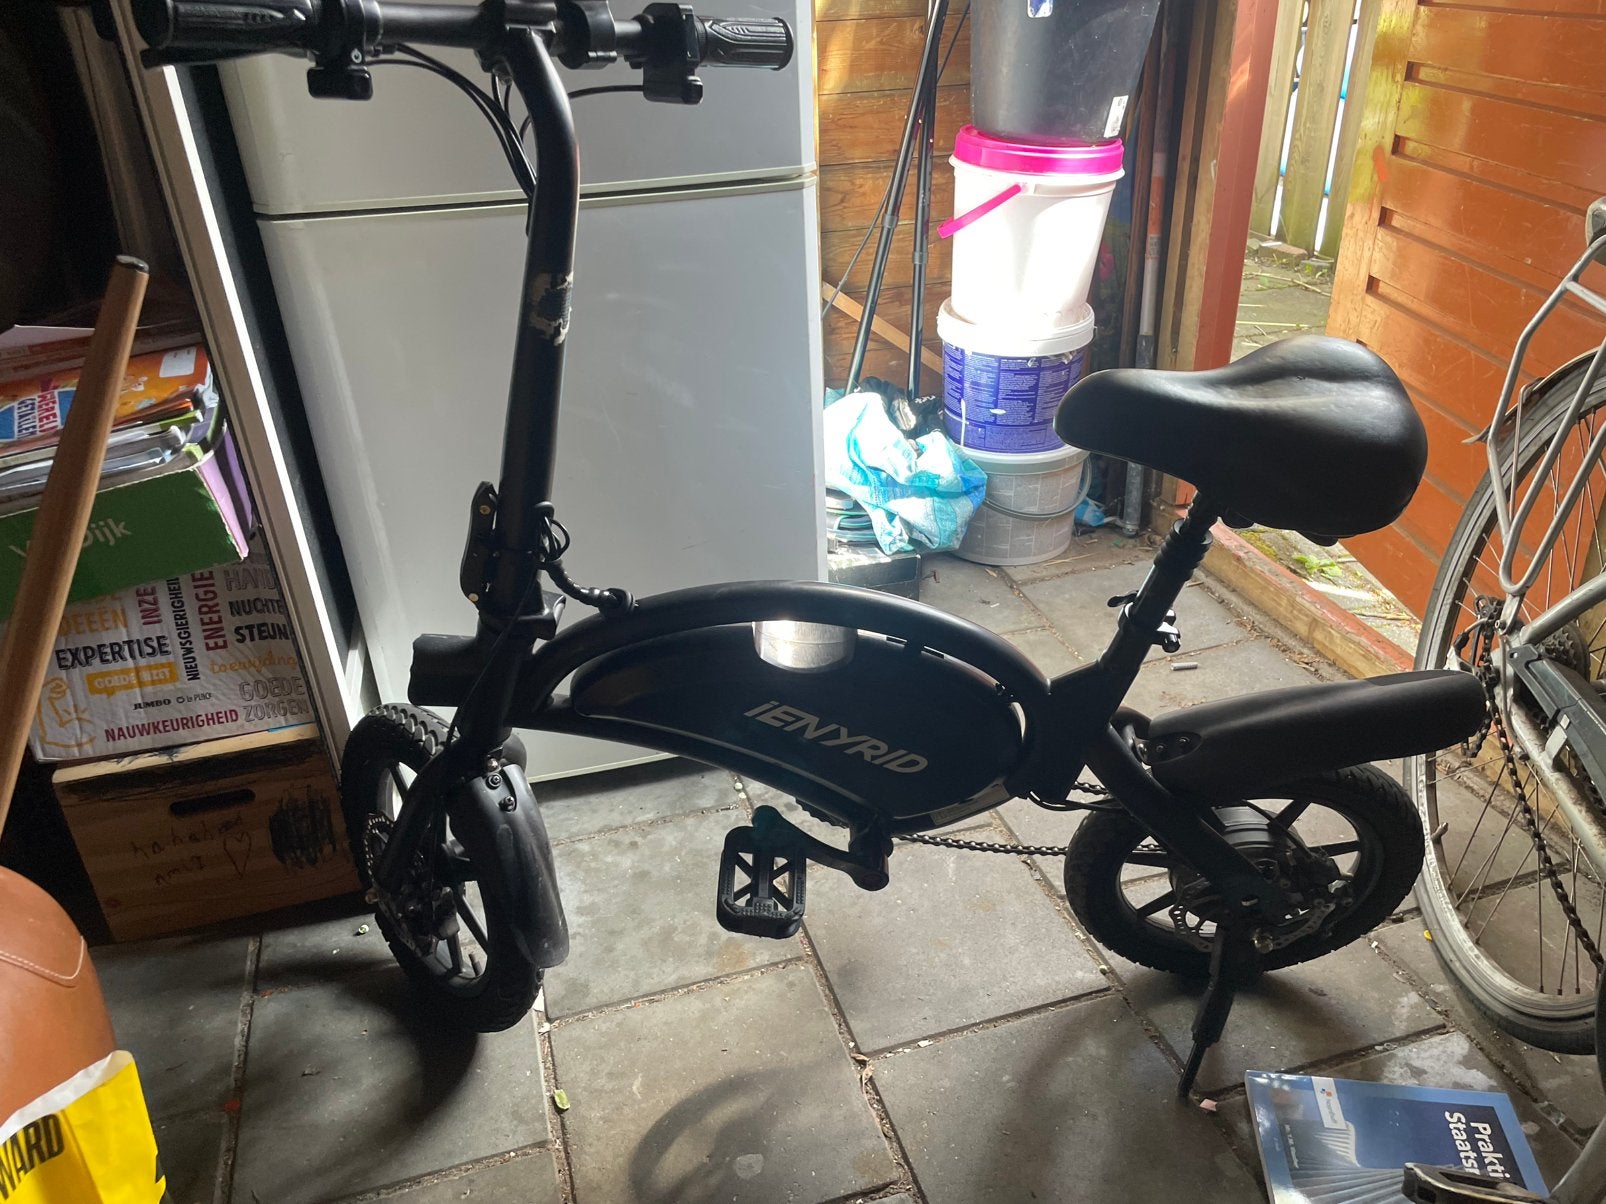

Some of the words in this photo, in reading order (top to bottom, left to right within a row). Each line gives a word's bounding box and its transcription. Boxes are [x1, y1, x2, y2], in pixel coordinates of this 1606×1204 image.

[191, 570, 229, 652] ENERGIE
[55, 635, 172, 670] EXPERTISE
[132, 698, 172, 711] JUMBO
[239, 676, 305, 701] GOEDE
[104, 708, 239, 742] NAUWKEURIGHEID
[242, 699, 310, 722] ZORGEN
[1470, 1121, 1511, 1179] Prakti
